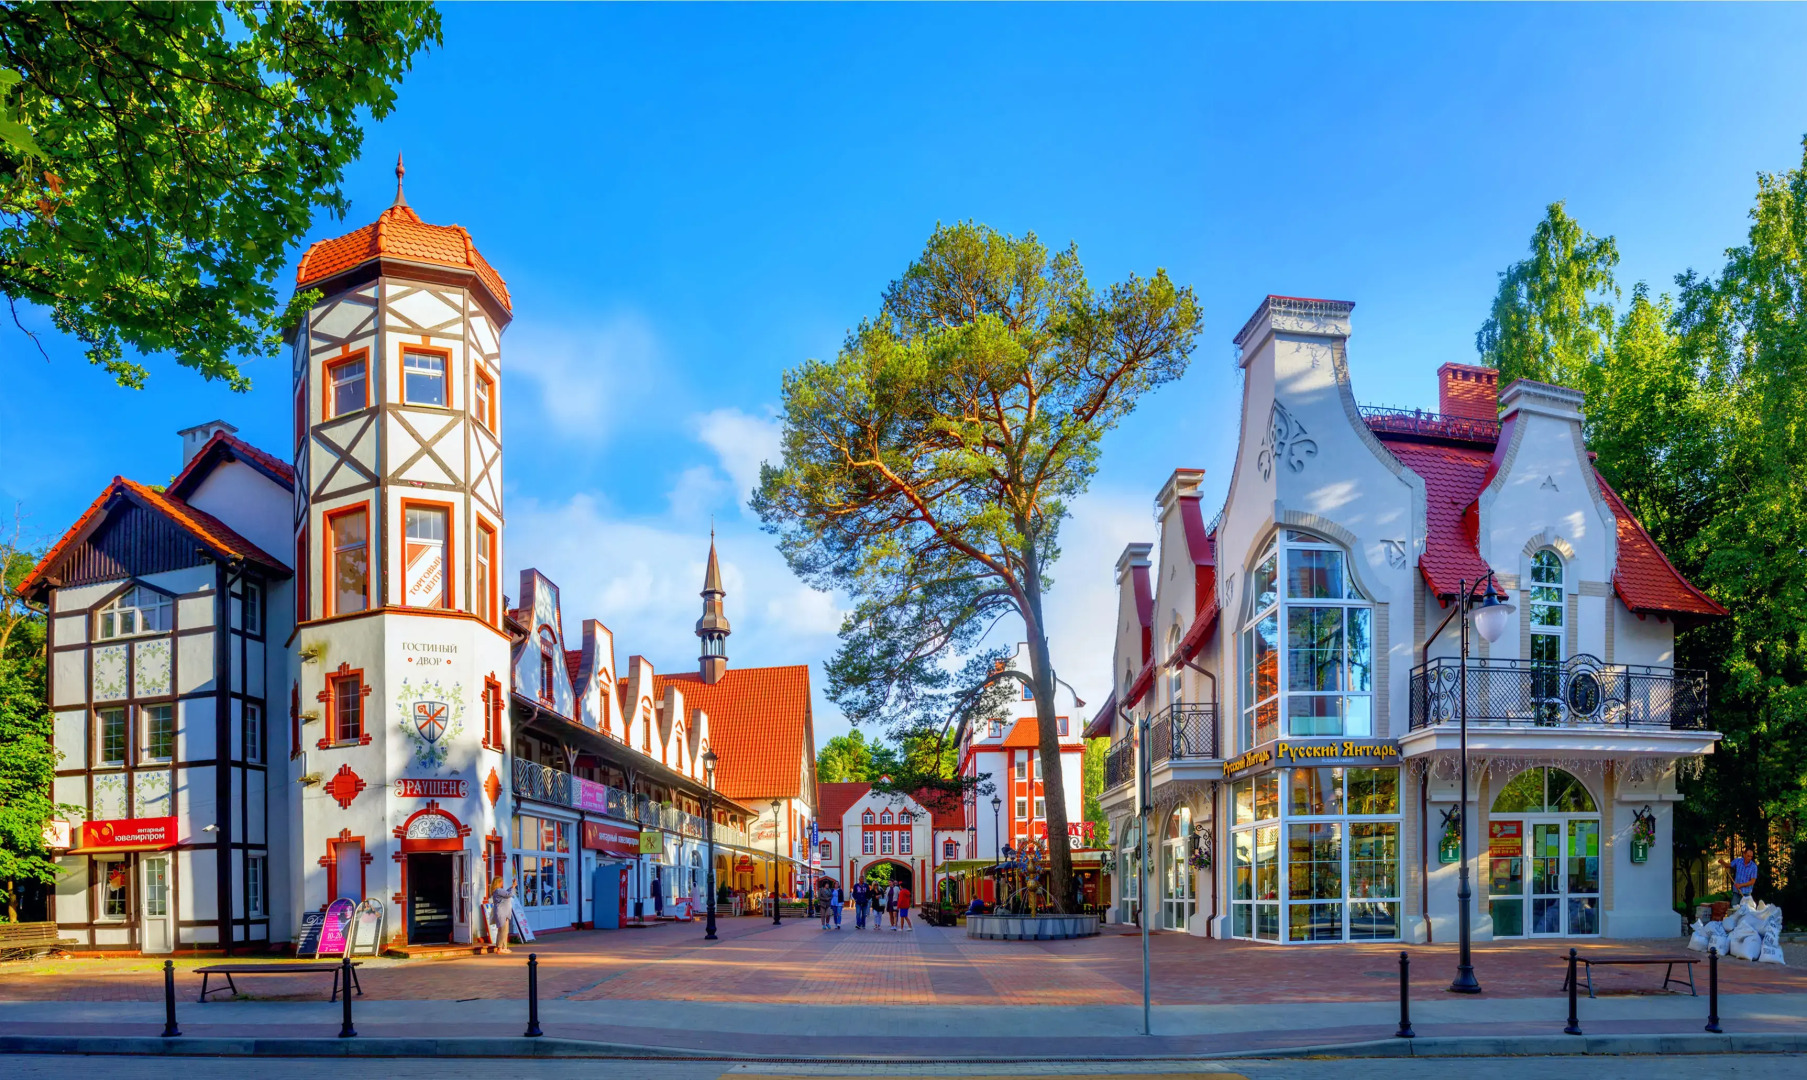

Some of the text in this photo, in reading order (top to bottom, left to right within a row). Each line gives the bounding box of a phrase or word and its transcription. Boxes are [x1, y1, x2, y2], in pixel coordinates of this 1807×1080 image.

[402, 642, 457, 653] ГОСТИНЫЙ
[416, 656, 442, 666] ДВОР
[1277, 741, 1396, 762] Русский Янтарь
[1223, 757, 1245, 778] Русский
[1246, 750, 1270, 766] Янтарь
[406, 780, 457, 795] РАУШЕН
[114, 832, 165, 843] ювелирпром
